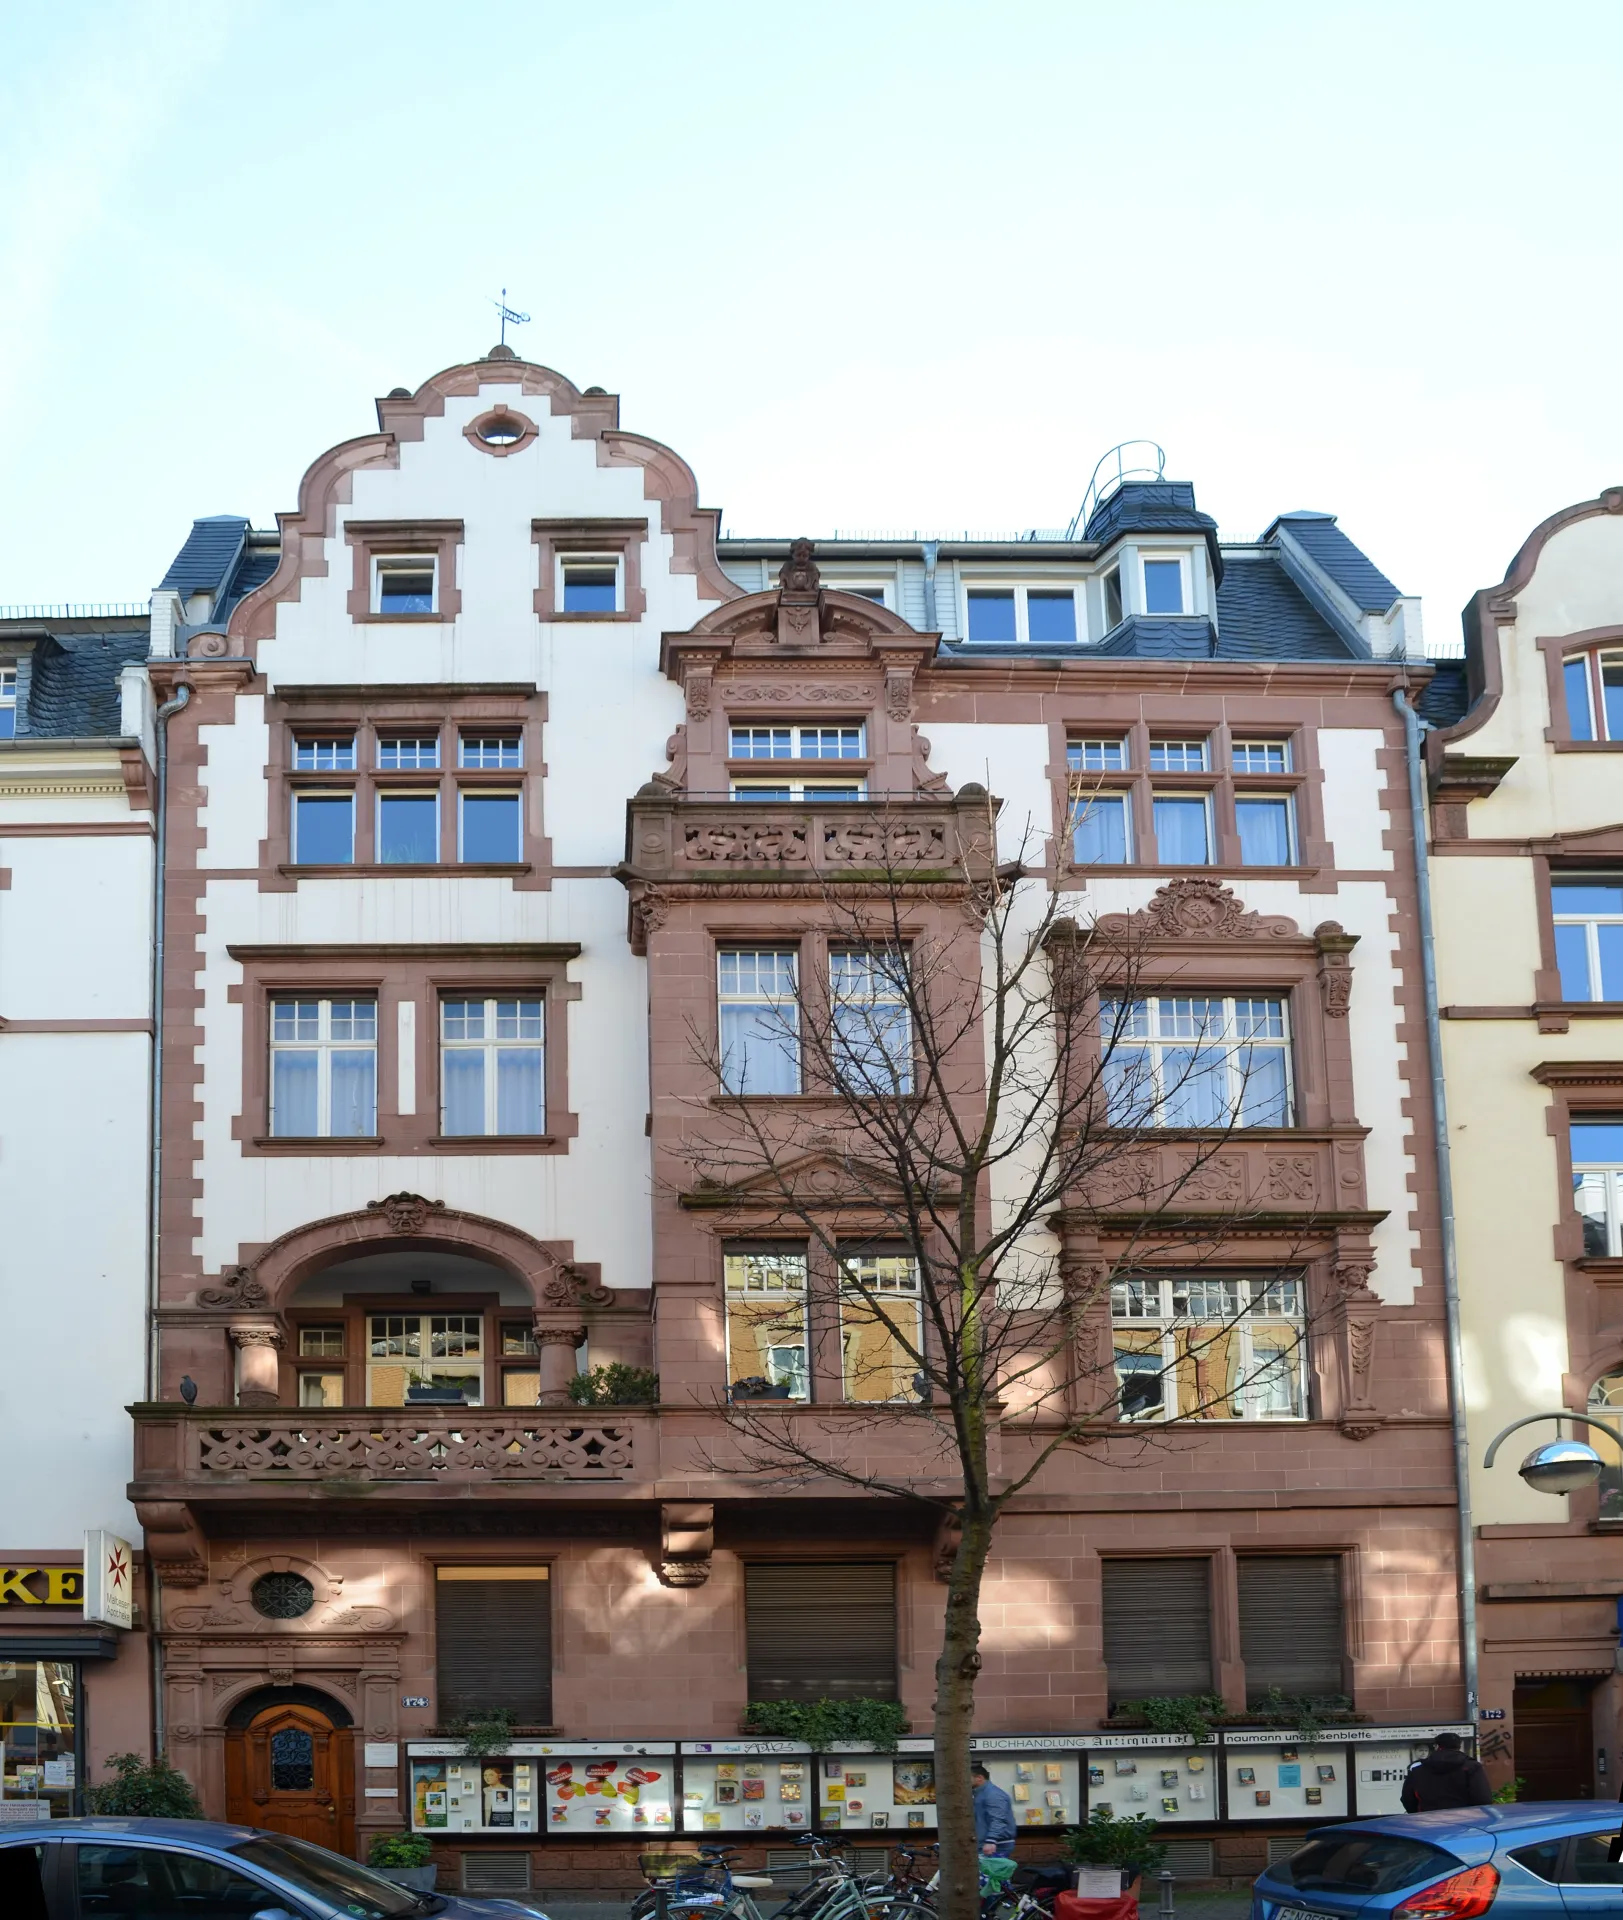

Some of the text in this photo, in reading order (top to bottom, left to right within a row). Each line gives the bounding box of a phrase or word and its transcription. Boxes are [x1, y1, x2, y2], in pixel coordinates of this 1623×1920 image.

[106, 1604, 131, 1621] Apotheke
[406, 1697, 425, 1706] 174
[1485, 1710, 1502, 1719] 172
[982, 1738, 1086, 1749] BUCHHANDLUNG
[1226, 1735, 1282, 1743] naumann
